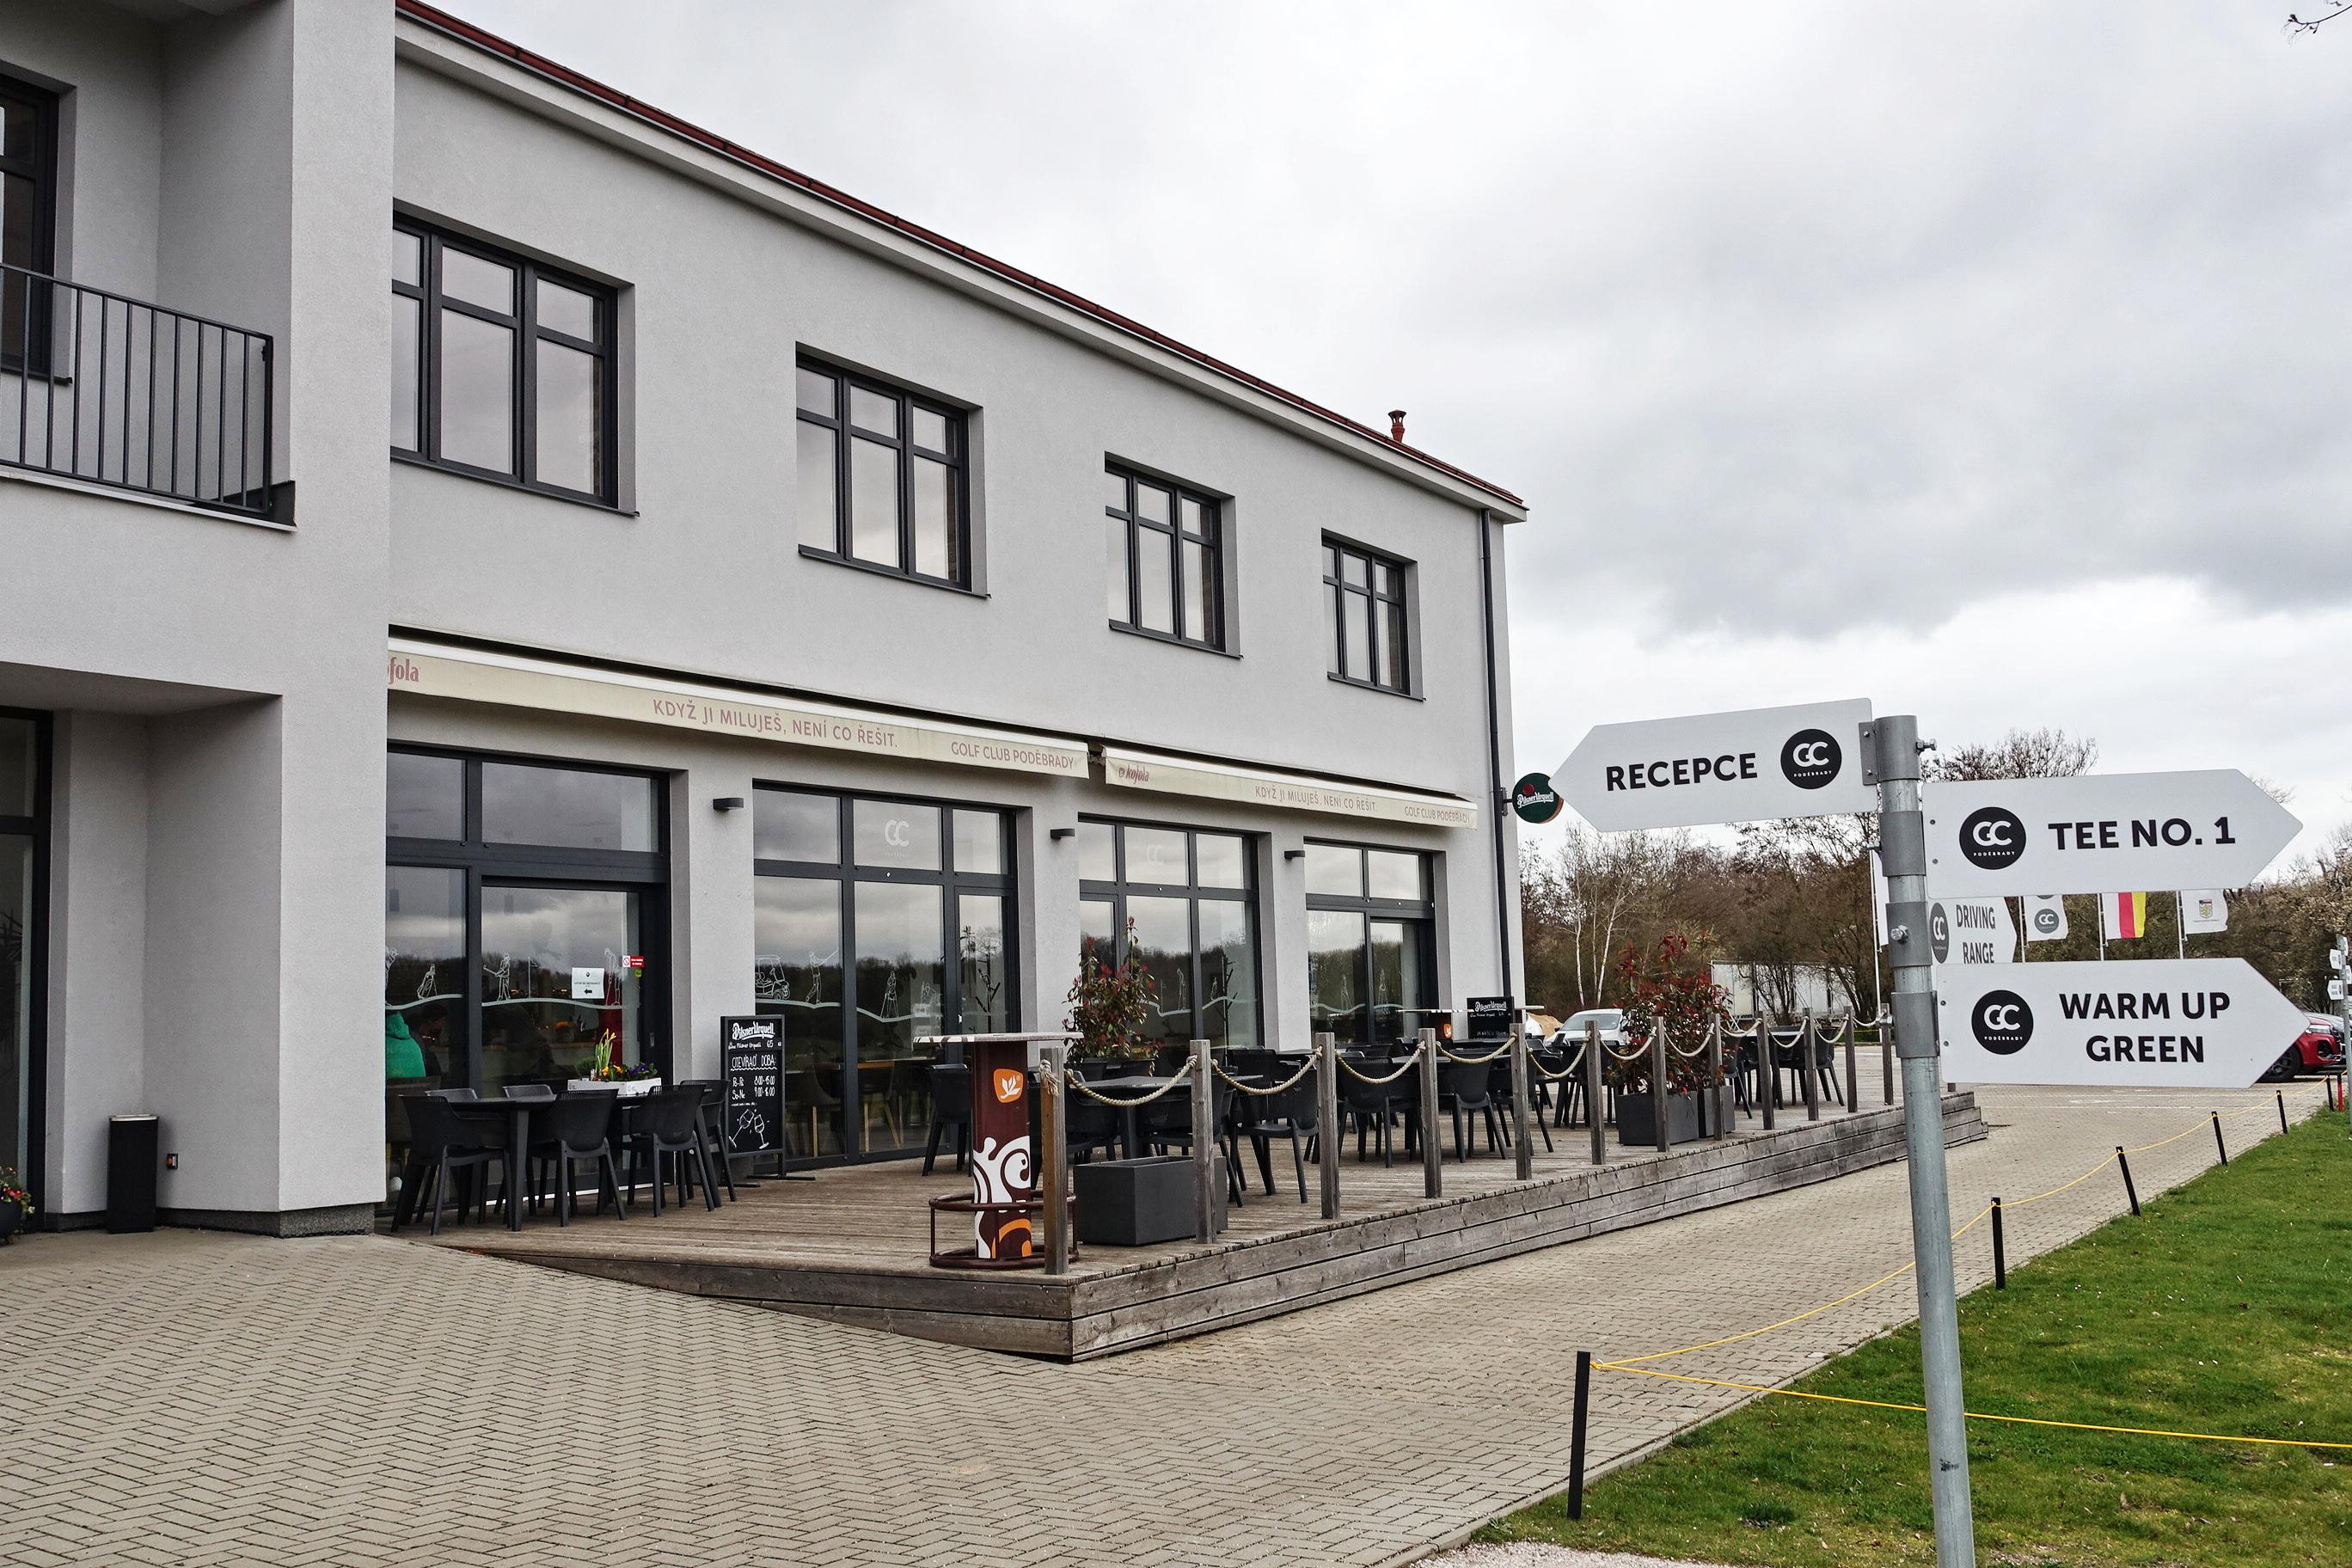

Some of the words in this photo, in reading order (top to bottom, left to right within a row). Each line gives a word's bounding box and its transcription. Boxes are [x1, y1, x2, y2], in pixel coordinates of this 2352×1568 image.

[388, 657, 420, 684] fola
[653, 699, 696, 720] KDYŽ
[702, 707, 714, 725] JI
[720, 709, 786, 734] MILUJEŠ,
[793, 720, 827, 738] NENÍ
[833, 726, 852, 741] CO
[858, 725, 897, 747] ŘEŠIT.
[952, 742, 980, 757] GOLF
[983, 746, 1010, 761] CLUB
[1014, 749, 1074, 769] PODĚBRADY
[1606, 752, 1757, 791] RECEPCE
[1255, 785, 1277, 799] KDYŽ
[1279, 791, 1285, 802] JI
[1324, 794, 1341, 807] NENÍ
[1344, 798, 1353, 809] CO
[1404, 806, 1419, 817] GOLF
[1421, 809, 1436, 819] CLUB
[2048, 820, 2119, 850] TEE
[2131, 818, 2202, 848] NO.
[2214, 817, 2235, 844] 1
[1956, 904, 1995, 929] DRIVING
[1963, 942, 1994, 964] RANGE
[2059, 992, 2171, 1020] WARM
[2182, 992, 2230, 1020] UP
[732, 1022, 754, 1040] Pilsner
[753, 1021, 775, 1038] Urquell
[2086, 1035, 2204, 1063] GREEN
